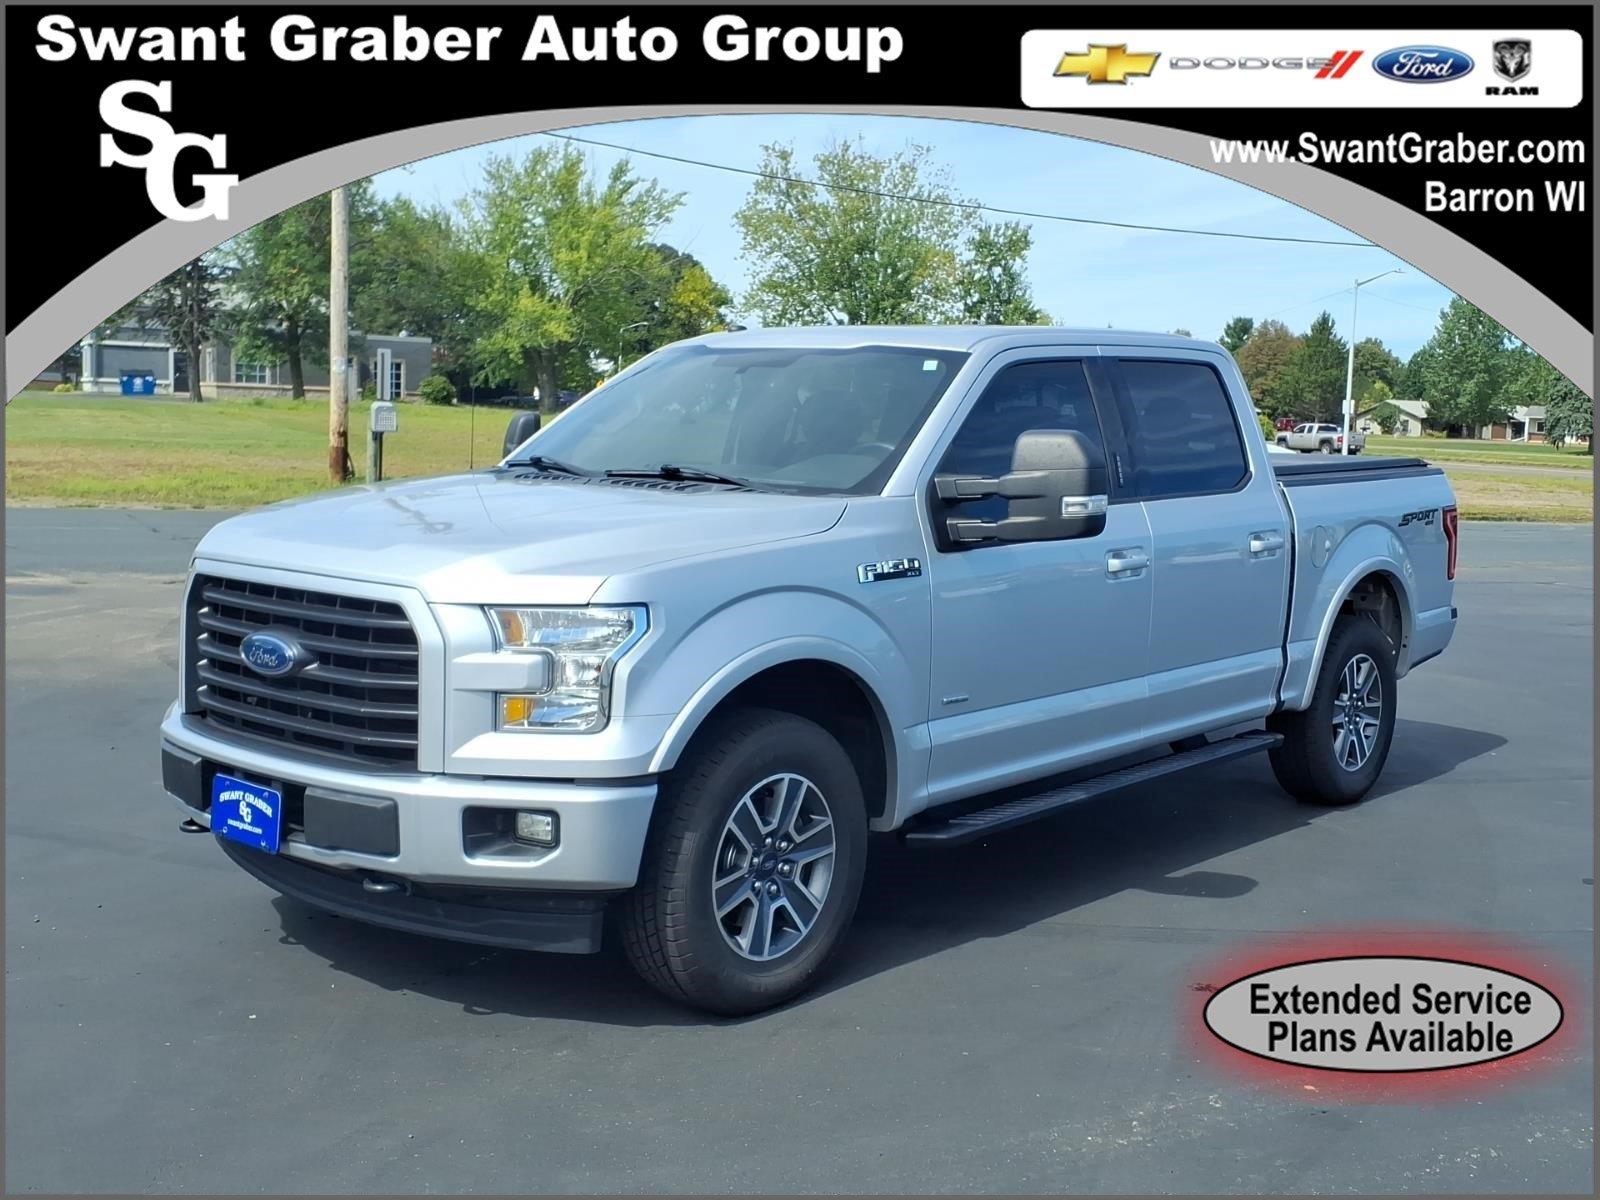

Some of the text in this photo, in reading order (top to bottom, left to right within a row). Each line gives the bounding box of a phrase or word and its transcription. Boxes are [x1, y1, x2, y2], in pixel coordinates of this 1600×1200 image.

[1398, 508, 1439, 527] SPORT
[249, 642, 279, 667] Ford
[219, 790, 273, 818] SWANT GRABER
